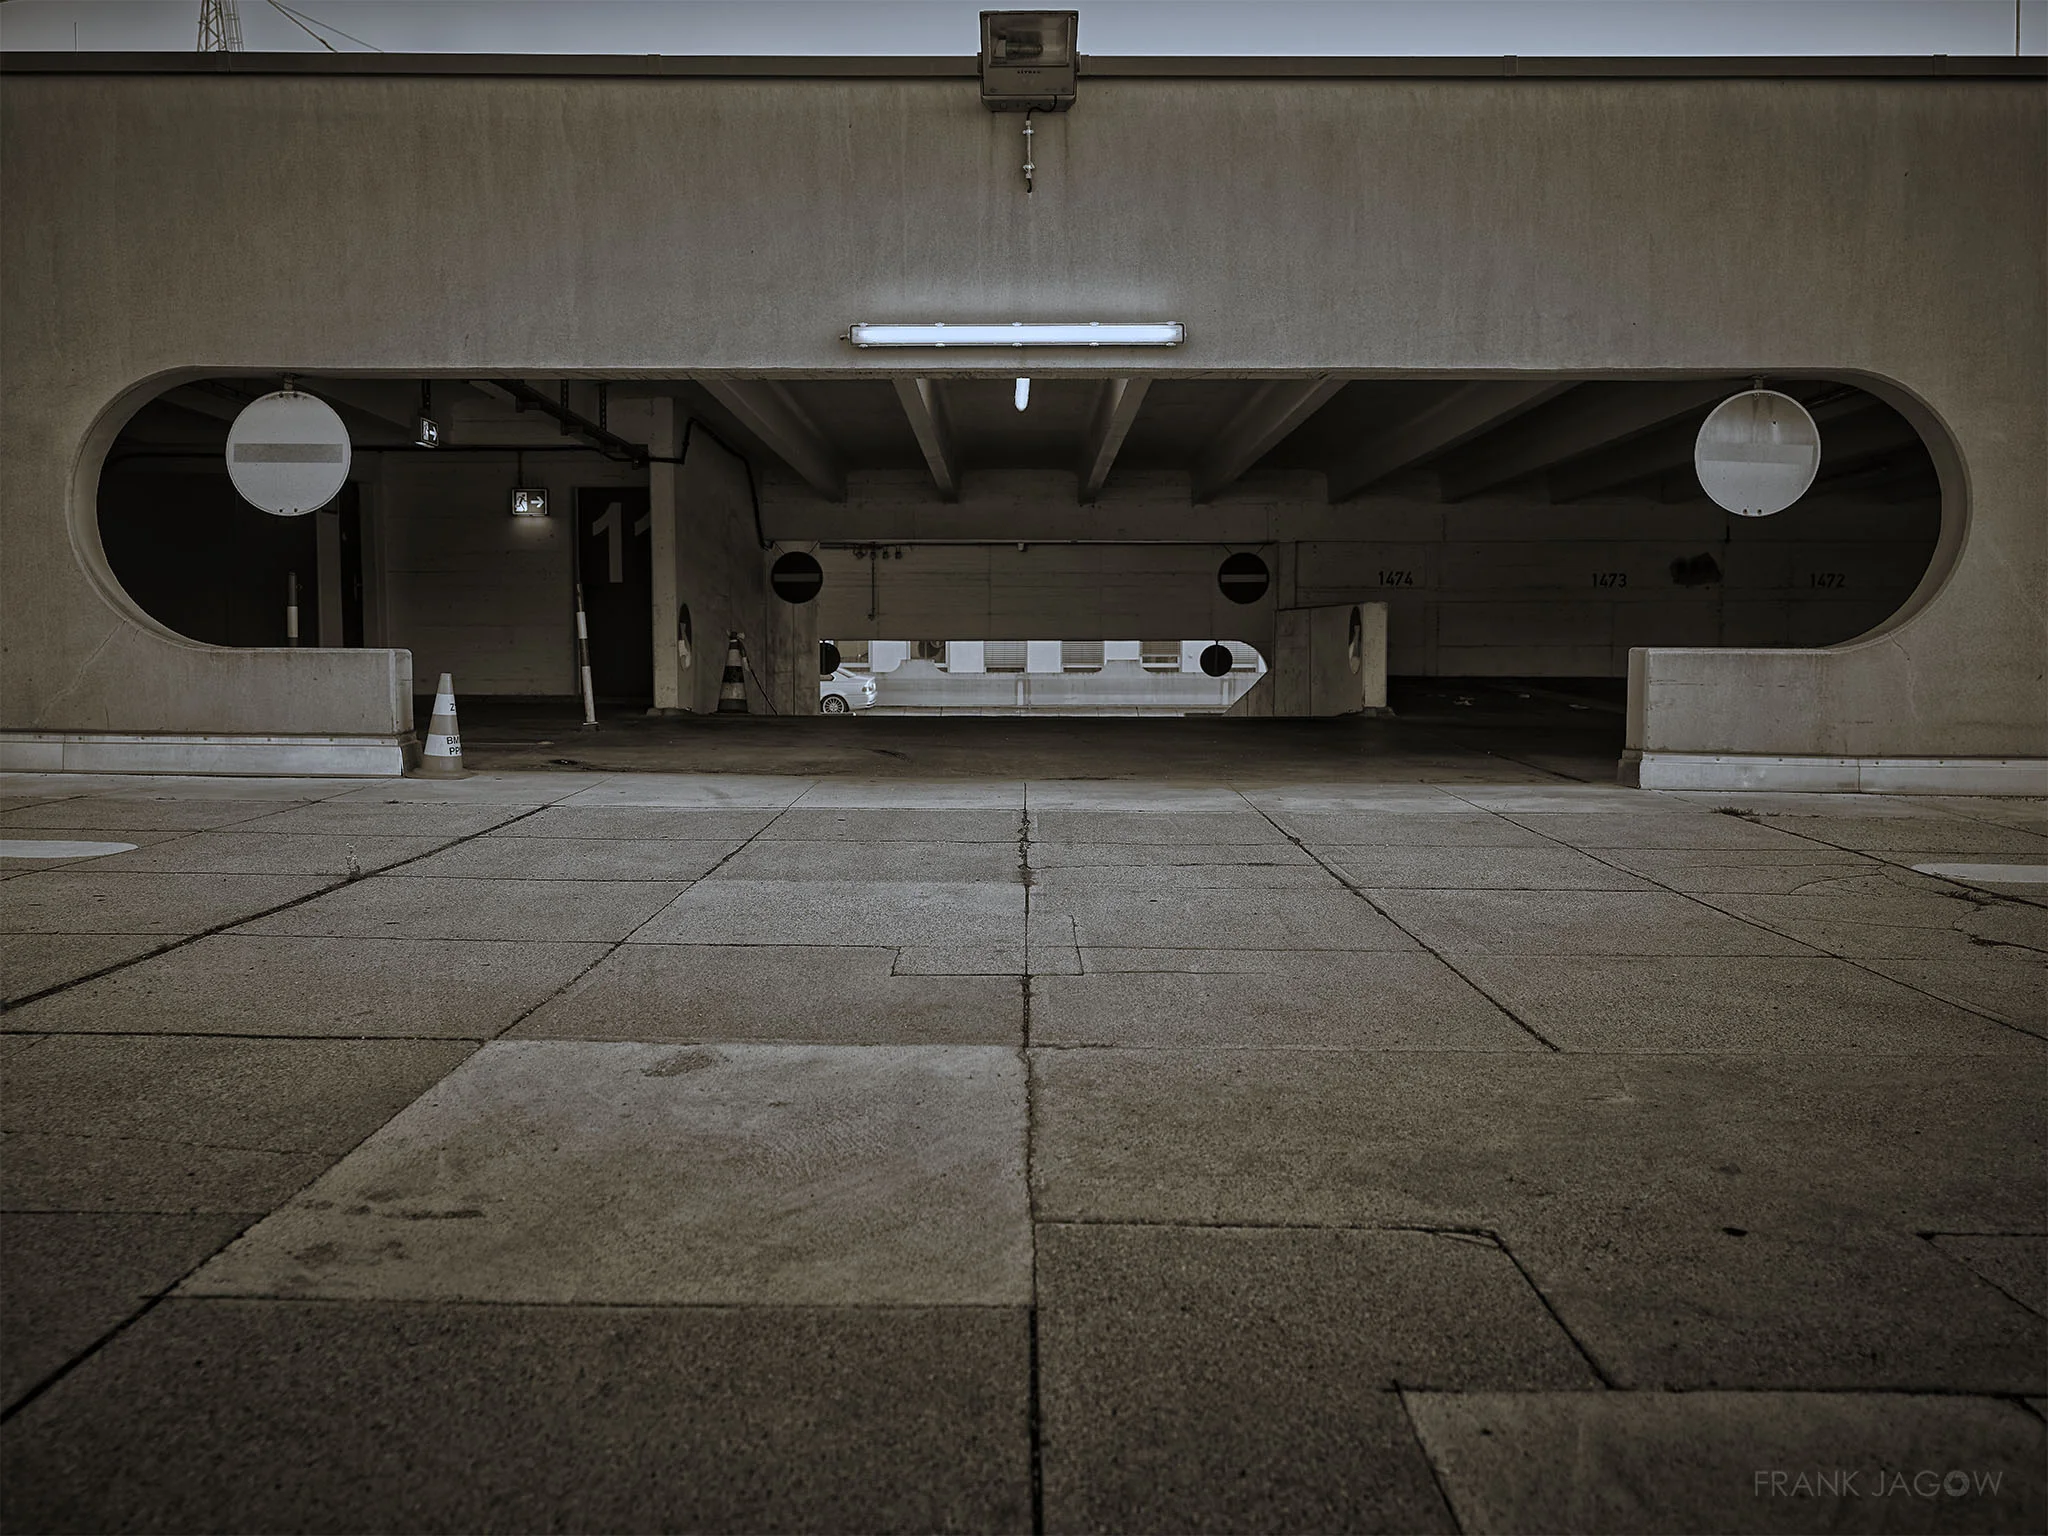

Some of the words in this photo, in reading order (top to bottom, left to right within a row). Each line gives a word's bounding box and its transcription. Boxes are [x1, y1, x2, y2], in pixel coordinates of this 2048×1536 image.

[1379, 571, 1414, 586] 1474
[1592, 573, 1627, 588] 1473
[1810, 573, 1845, 588] 1472
